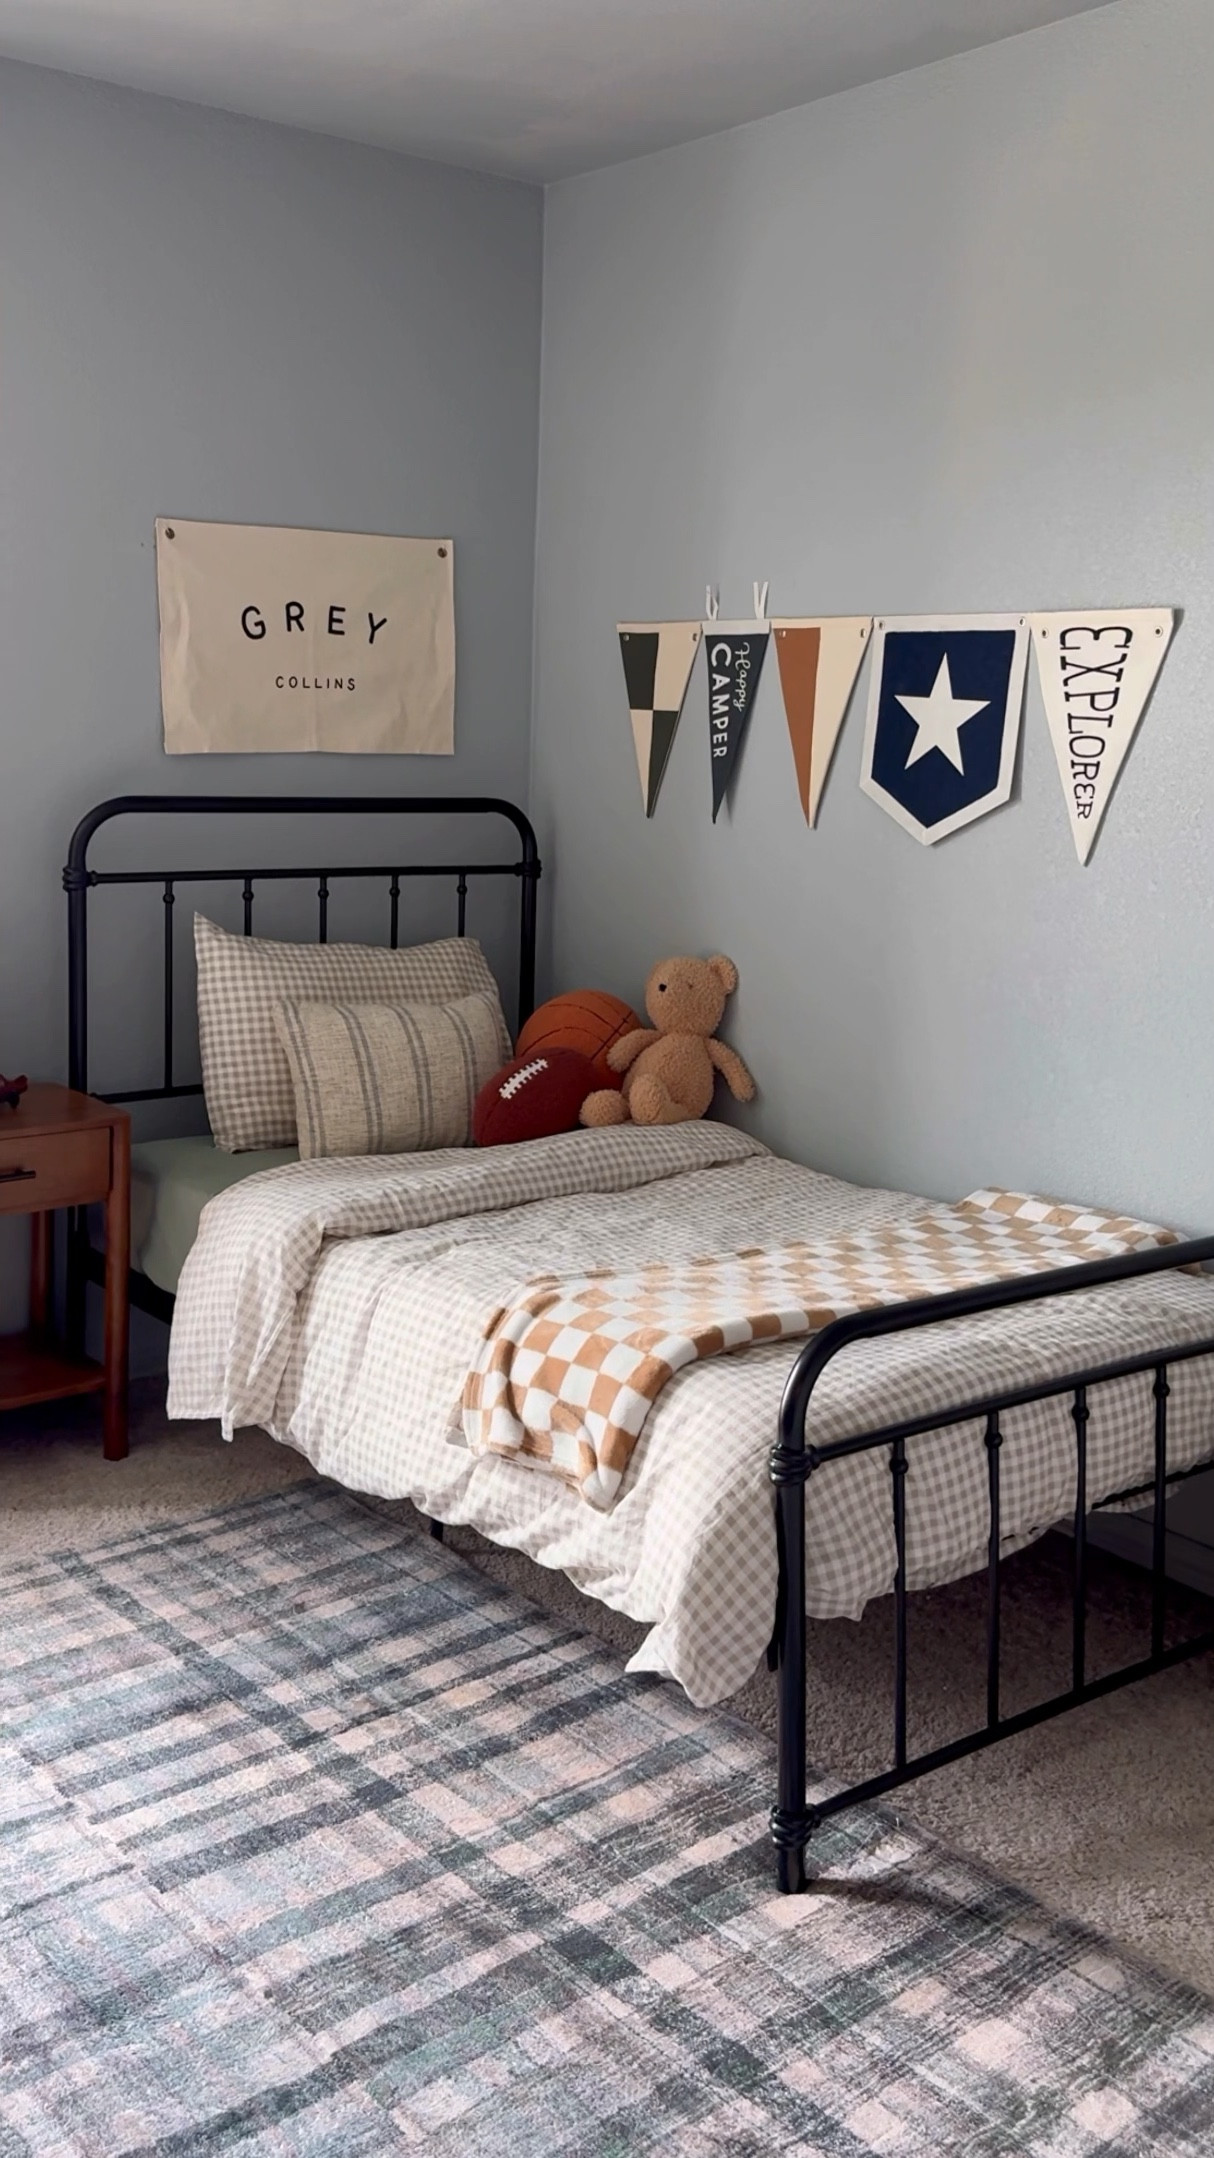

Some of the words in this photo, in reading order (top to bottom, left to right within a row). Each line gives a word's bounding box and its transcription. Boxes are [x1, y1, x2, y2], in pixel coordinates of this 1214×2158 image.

[241, 601, 388, 645] GREY
[275, 675, 356, 692] COLLINS
[710, 642, 732, 758] CAMPER
[733, 641, 751, 713] Happy
[1059, 626, 1134, 819] EXPLORER
